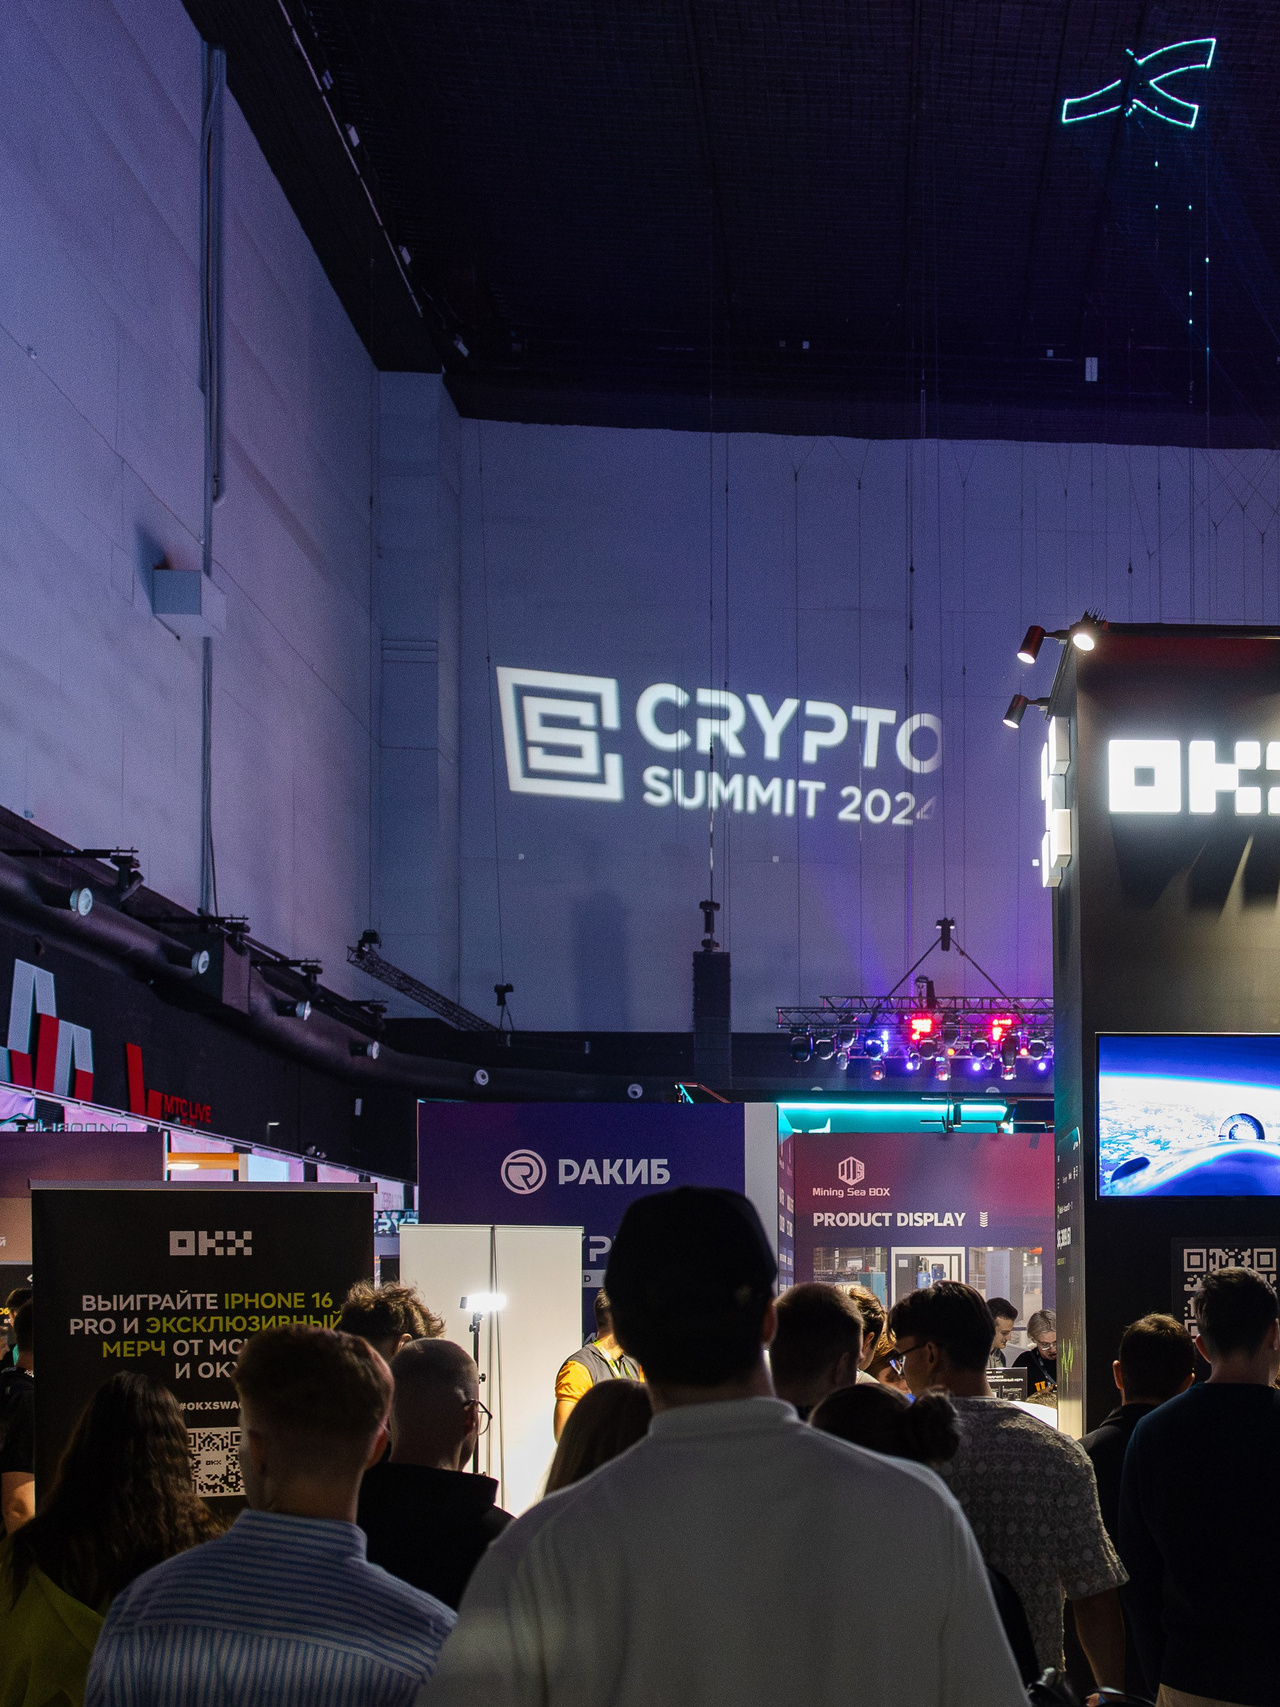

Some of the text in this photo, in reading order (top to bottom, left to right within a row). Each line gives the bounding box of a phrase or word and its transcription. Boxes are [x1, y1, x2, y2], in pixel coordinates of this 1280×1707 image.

[636, 682, 943, 774] CRYPTO
[643, 765, 827, 819] SUMMIT
[558, 1158, 671, 1185] РАКИБ
[812, 1187, 891, 1198] Mining Sea BOX
[813, 1212, 966, 1227] PRODUCT DISPLAY
[169, 1230, 253, 1256] OKX
[82, 1290, 333, 1312] ВЫИГРАЙТЕ IPHONE 16
[70, 1318, 116, 1335] PRO
[123, 1317, 139, 1334] И
[102, 1338, 248, 1358] МЕРЧ ОТ МС
[175, 1362, 190, 1379] И
[179, 1401, 242, 1411] #OKXSWA
